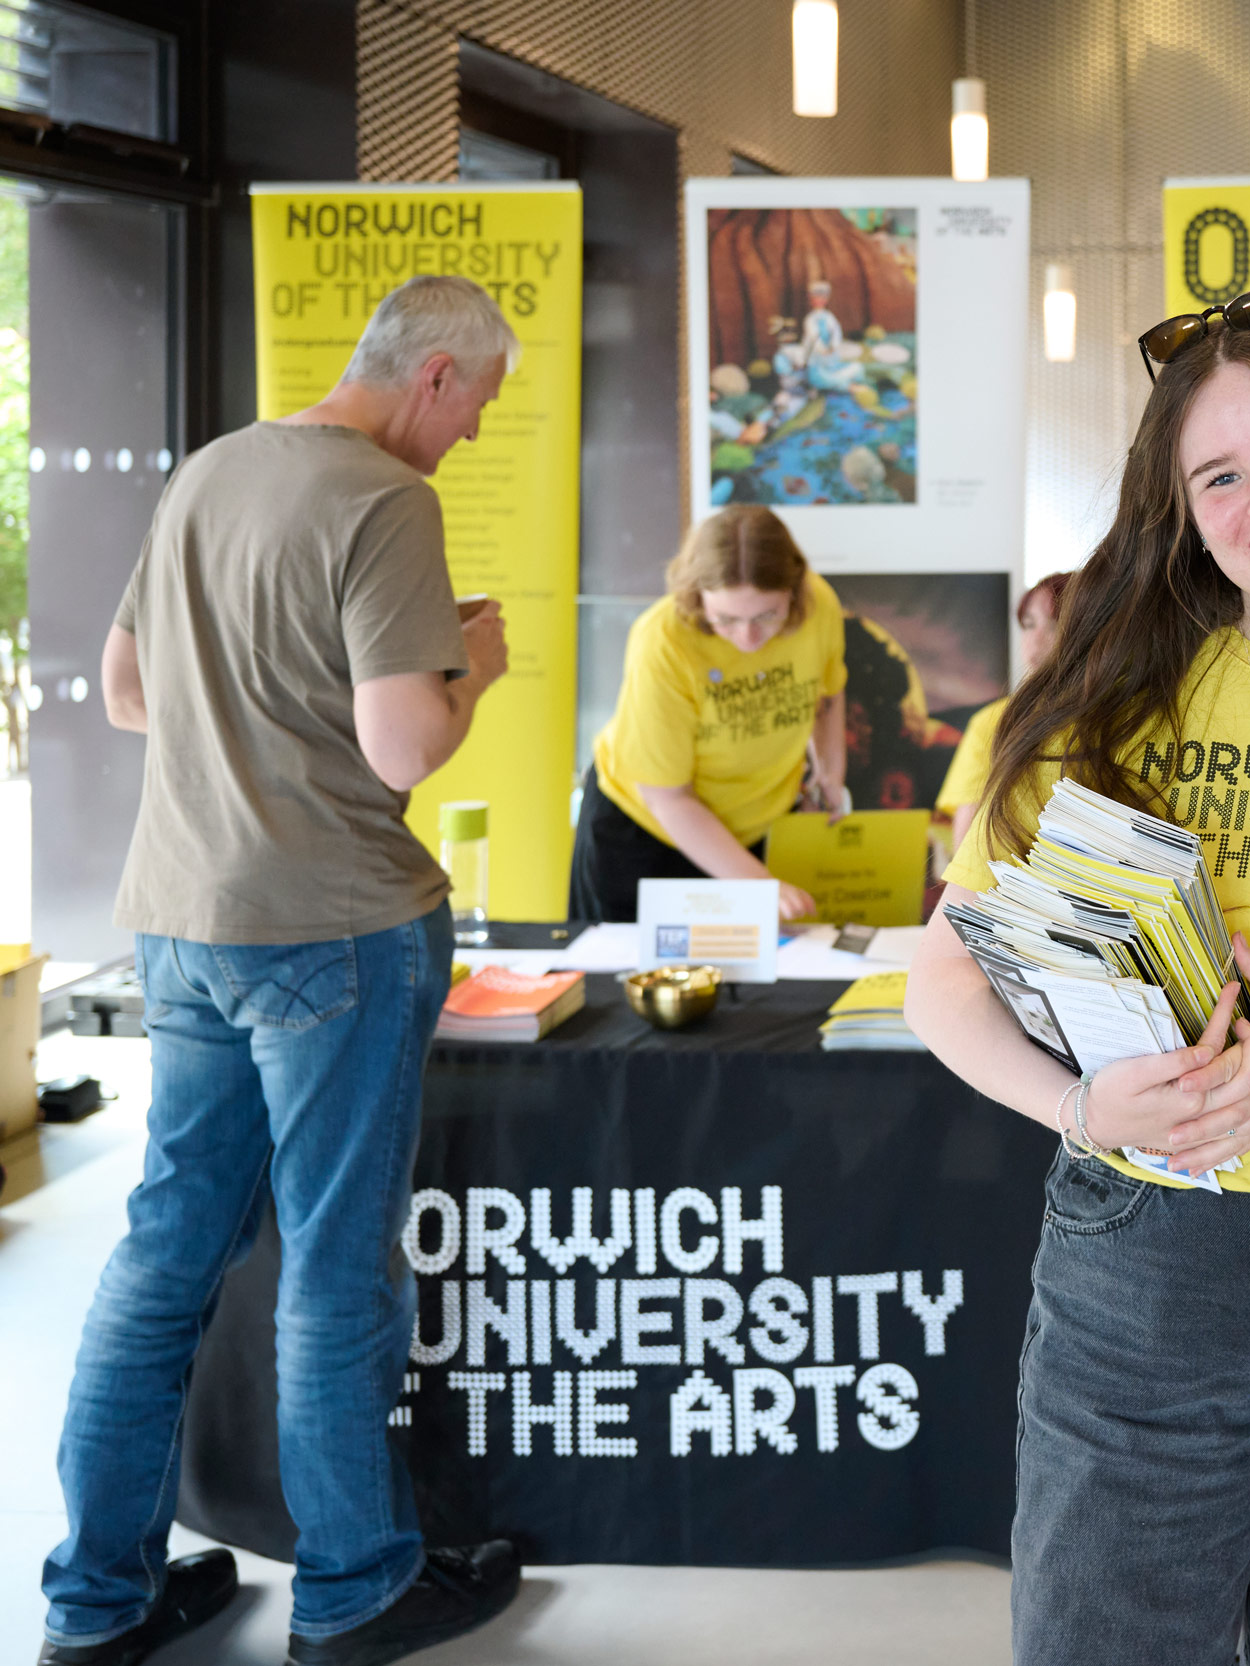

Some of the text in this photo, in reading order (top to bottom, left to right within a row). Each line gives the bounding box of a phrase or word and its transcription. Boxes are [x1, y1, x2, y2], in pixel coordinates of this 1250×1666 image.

[287, 202, 483, 239] NORWICH
[314, 241, 561, 279] UNIVERSITY
[271, 281, 538, 319] OF TH TS
[402, 1186, 783, 1275] ORWICH
[409, 1269, 964, 1366] UNIVERSITY
[448, 1369, 638, 1457] THE
[670, 1362, 920, 1457] ARTS
